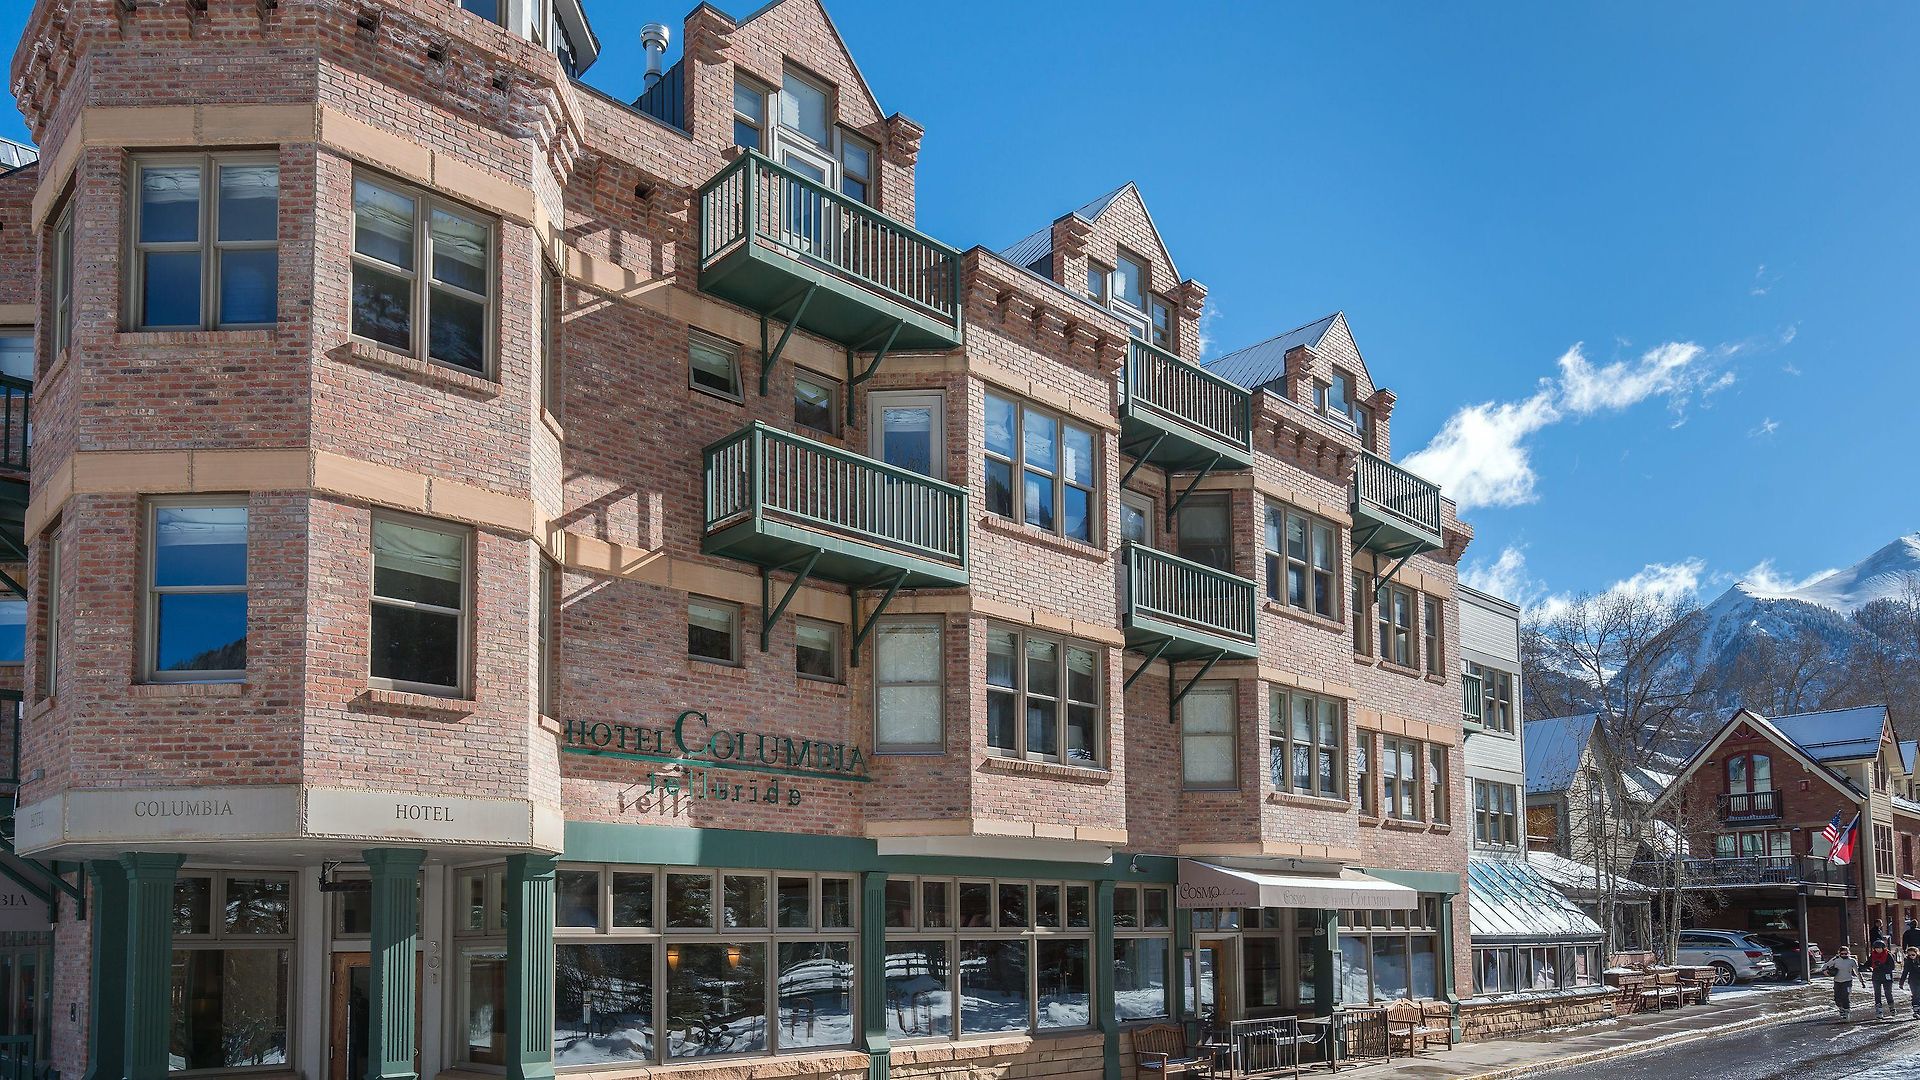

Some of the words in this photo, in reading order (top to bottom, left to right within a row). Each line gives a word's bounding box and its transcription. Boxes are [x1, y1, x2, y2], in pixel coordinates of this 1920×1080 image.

[565, 719, 672, 754] HOTEL
[674, 710, 869, 773] COLUMBIA
[649, 768, 801, 806] telluride
[134, 799, 234, 817] COLUMBIA
[395, 804, 454, 822] HOTEL
